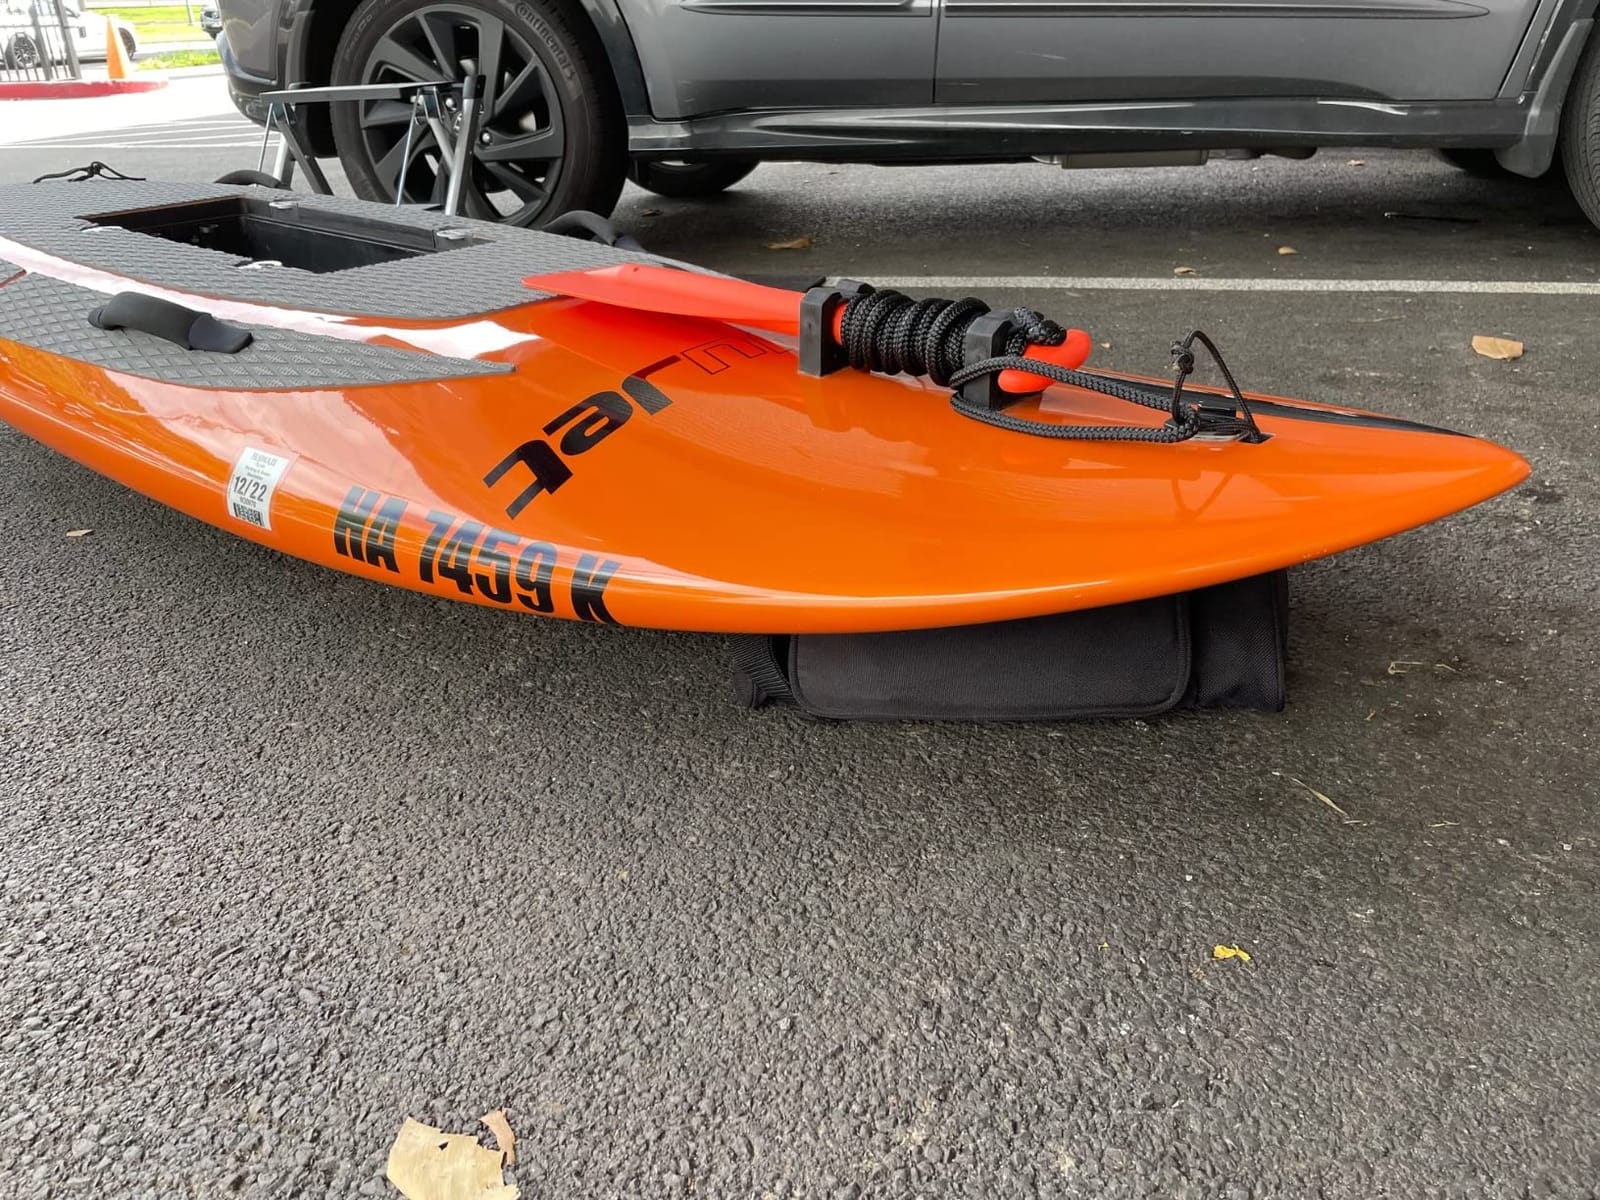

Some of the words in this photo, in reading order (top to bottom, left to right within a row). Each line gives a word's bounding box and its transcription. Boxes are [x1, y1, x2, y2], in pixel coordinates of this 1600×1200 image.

[515, 1, 572, 70] Continental
[233, 475, 268, 502] 12/22
[333, 485, 408, 573] HA
[419, 509, 557, 613] 7459
[571, 553, 626, 626] K
